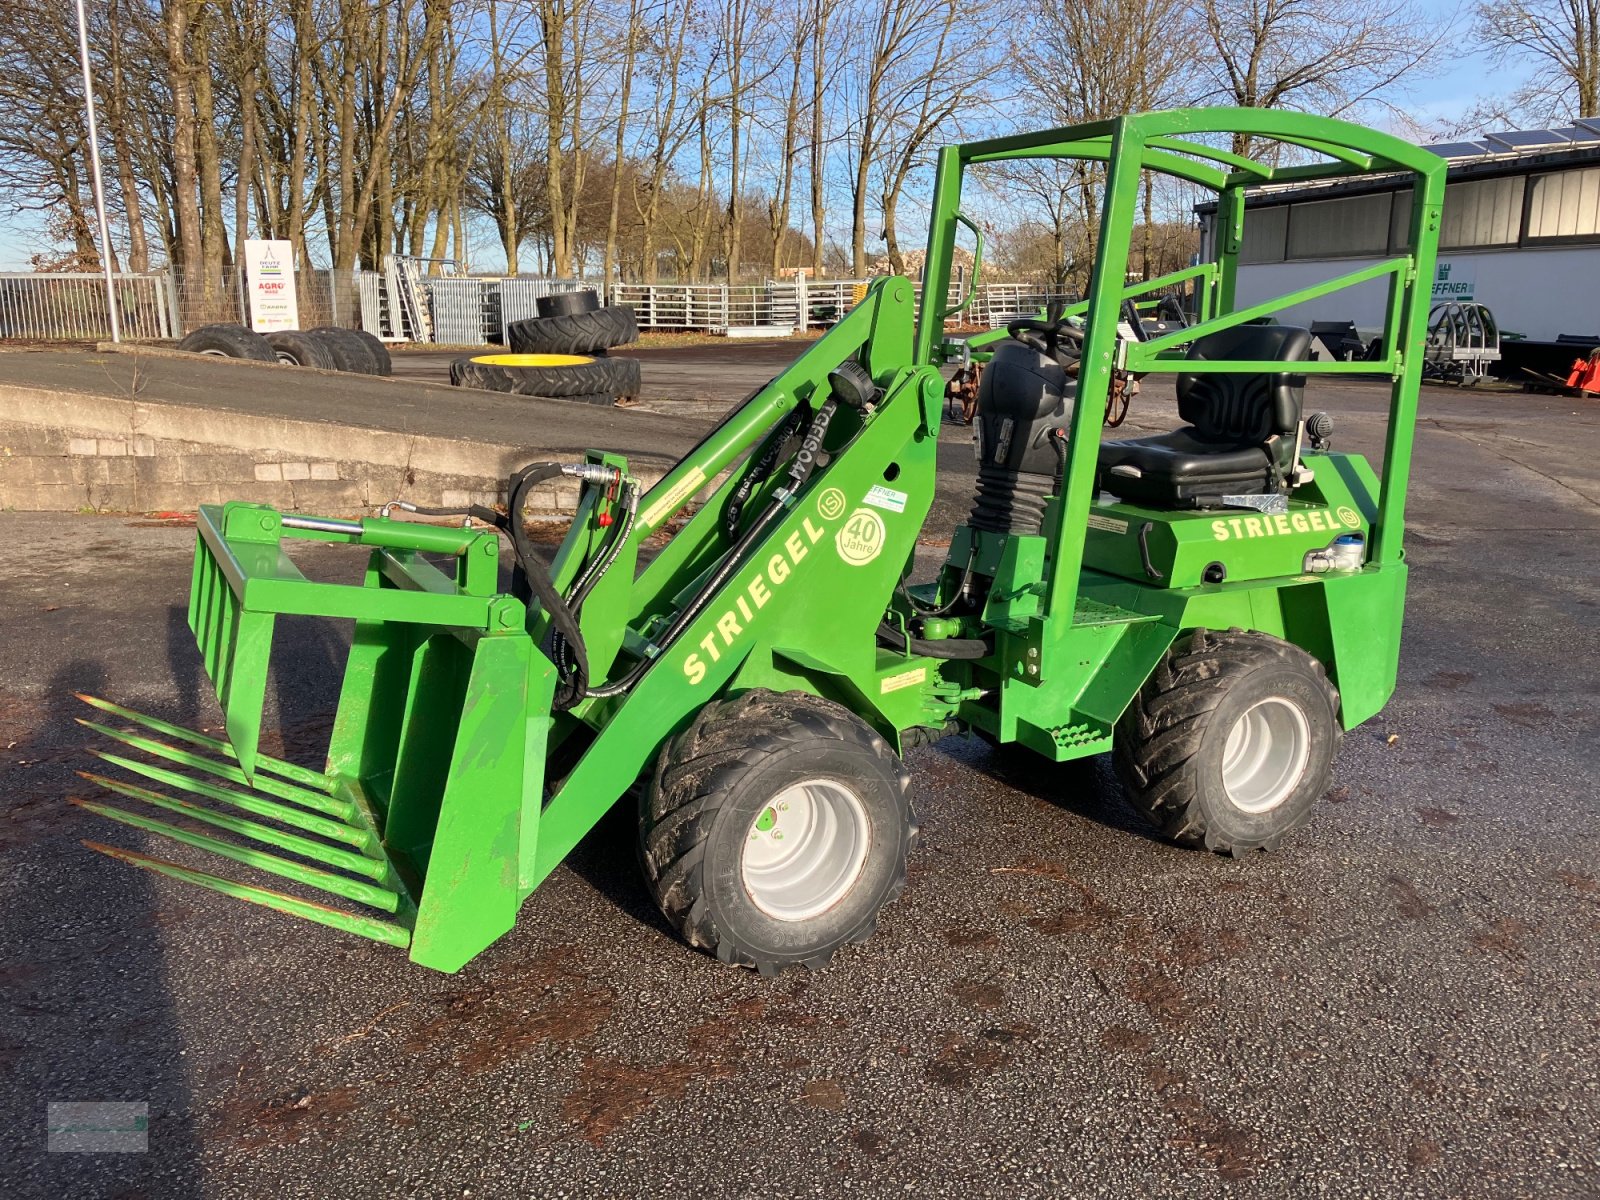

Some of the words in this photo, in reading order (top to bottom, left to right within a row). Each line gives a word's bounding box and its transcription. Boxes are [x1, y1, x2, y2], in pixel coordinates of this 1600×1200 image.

[848, 518, 876, 542] 40
[1212, 511, 1341, 541] STRIEGEL
[844, 538, 873, 553] Jahre
[684, 517, 825, 685] STRIEGEL
